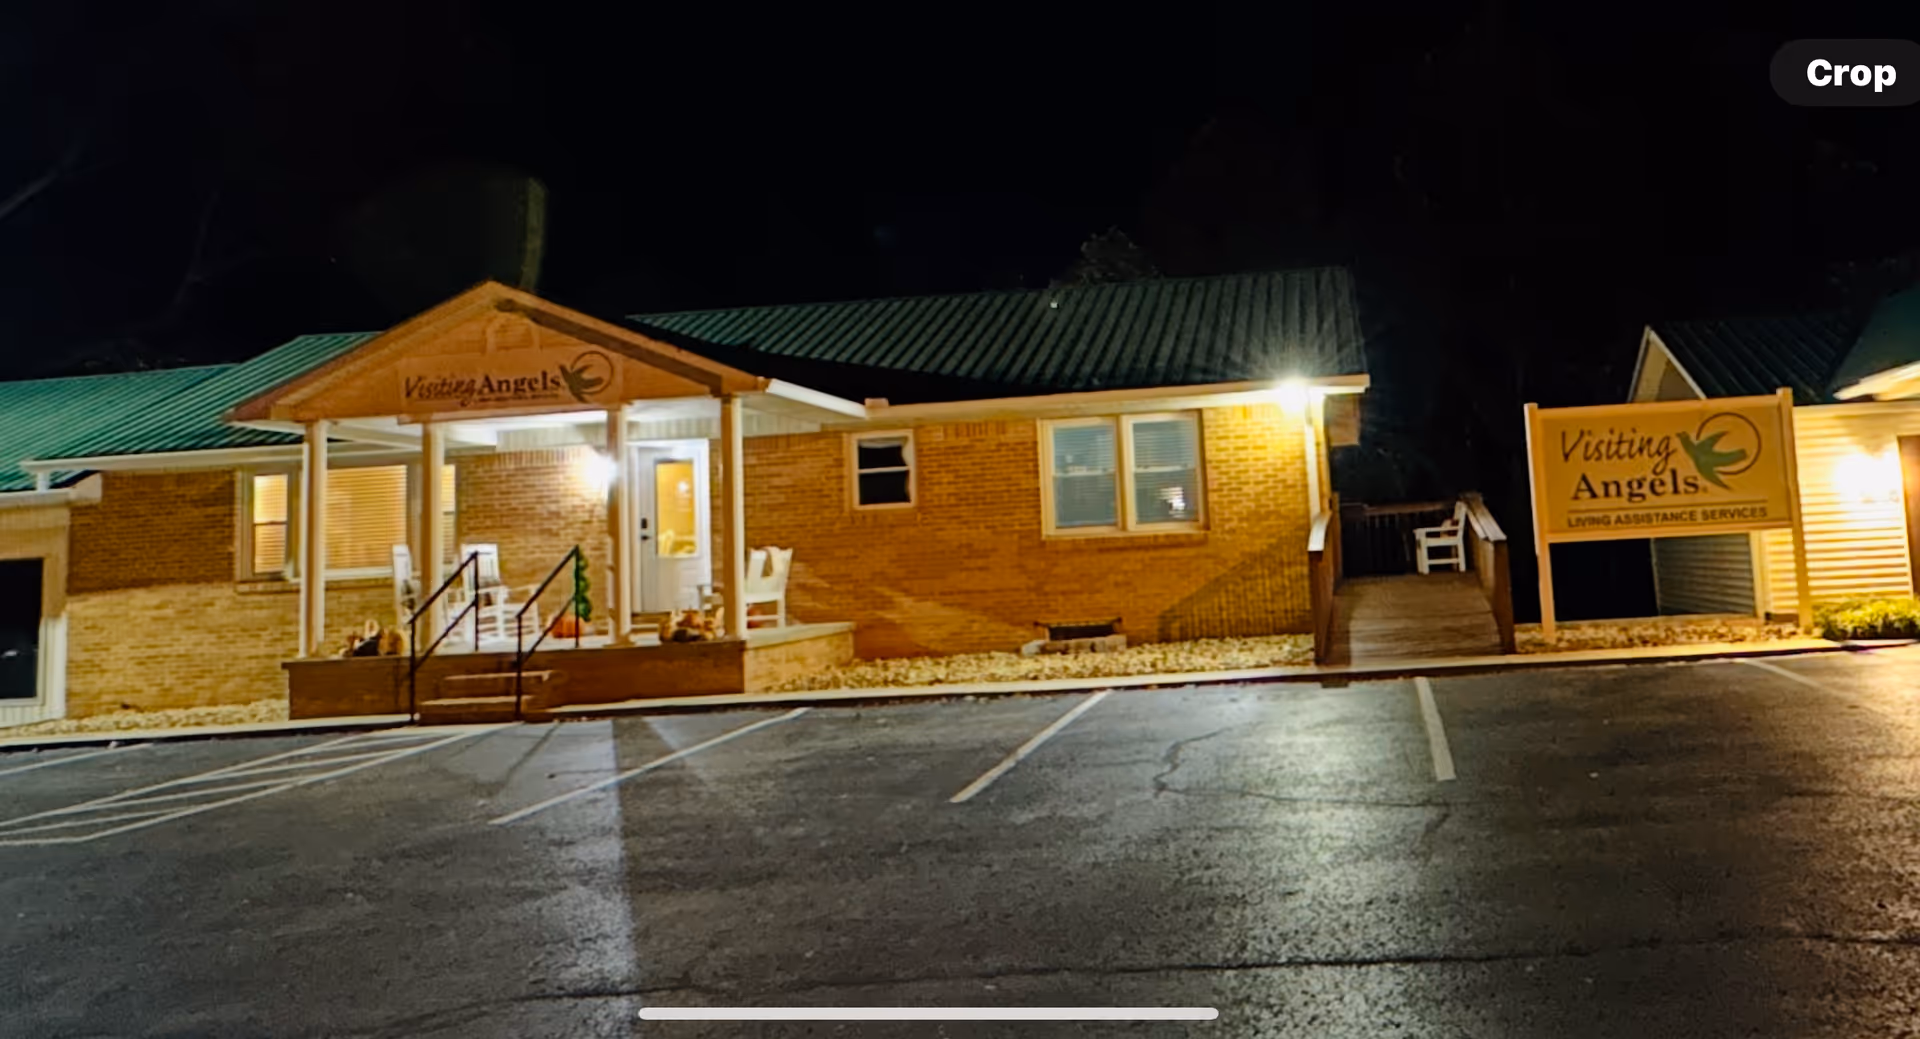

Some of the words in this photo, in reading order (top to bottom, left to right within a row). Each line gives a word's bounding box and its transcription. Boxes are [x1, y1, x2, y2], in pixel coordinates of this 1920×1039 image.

[404, 375, 477, 407] Visiting
[478, 370, 561, 396] Angels
[1560, 428, 1677, 476] Visiting
[1570, 468, 1700, 503] Angels
[1567, 514, 1612, 528] LIVING
[1614, 510, 1697, 527] ASSISTANCE
[1701, 506, 1768, 522] SERVICES
